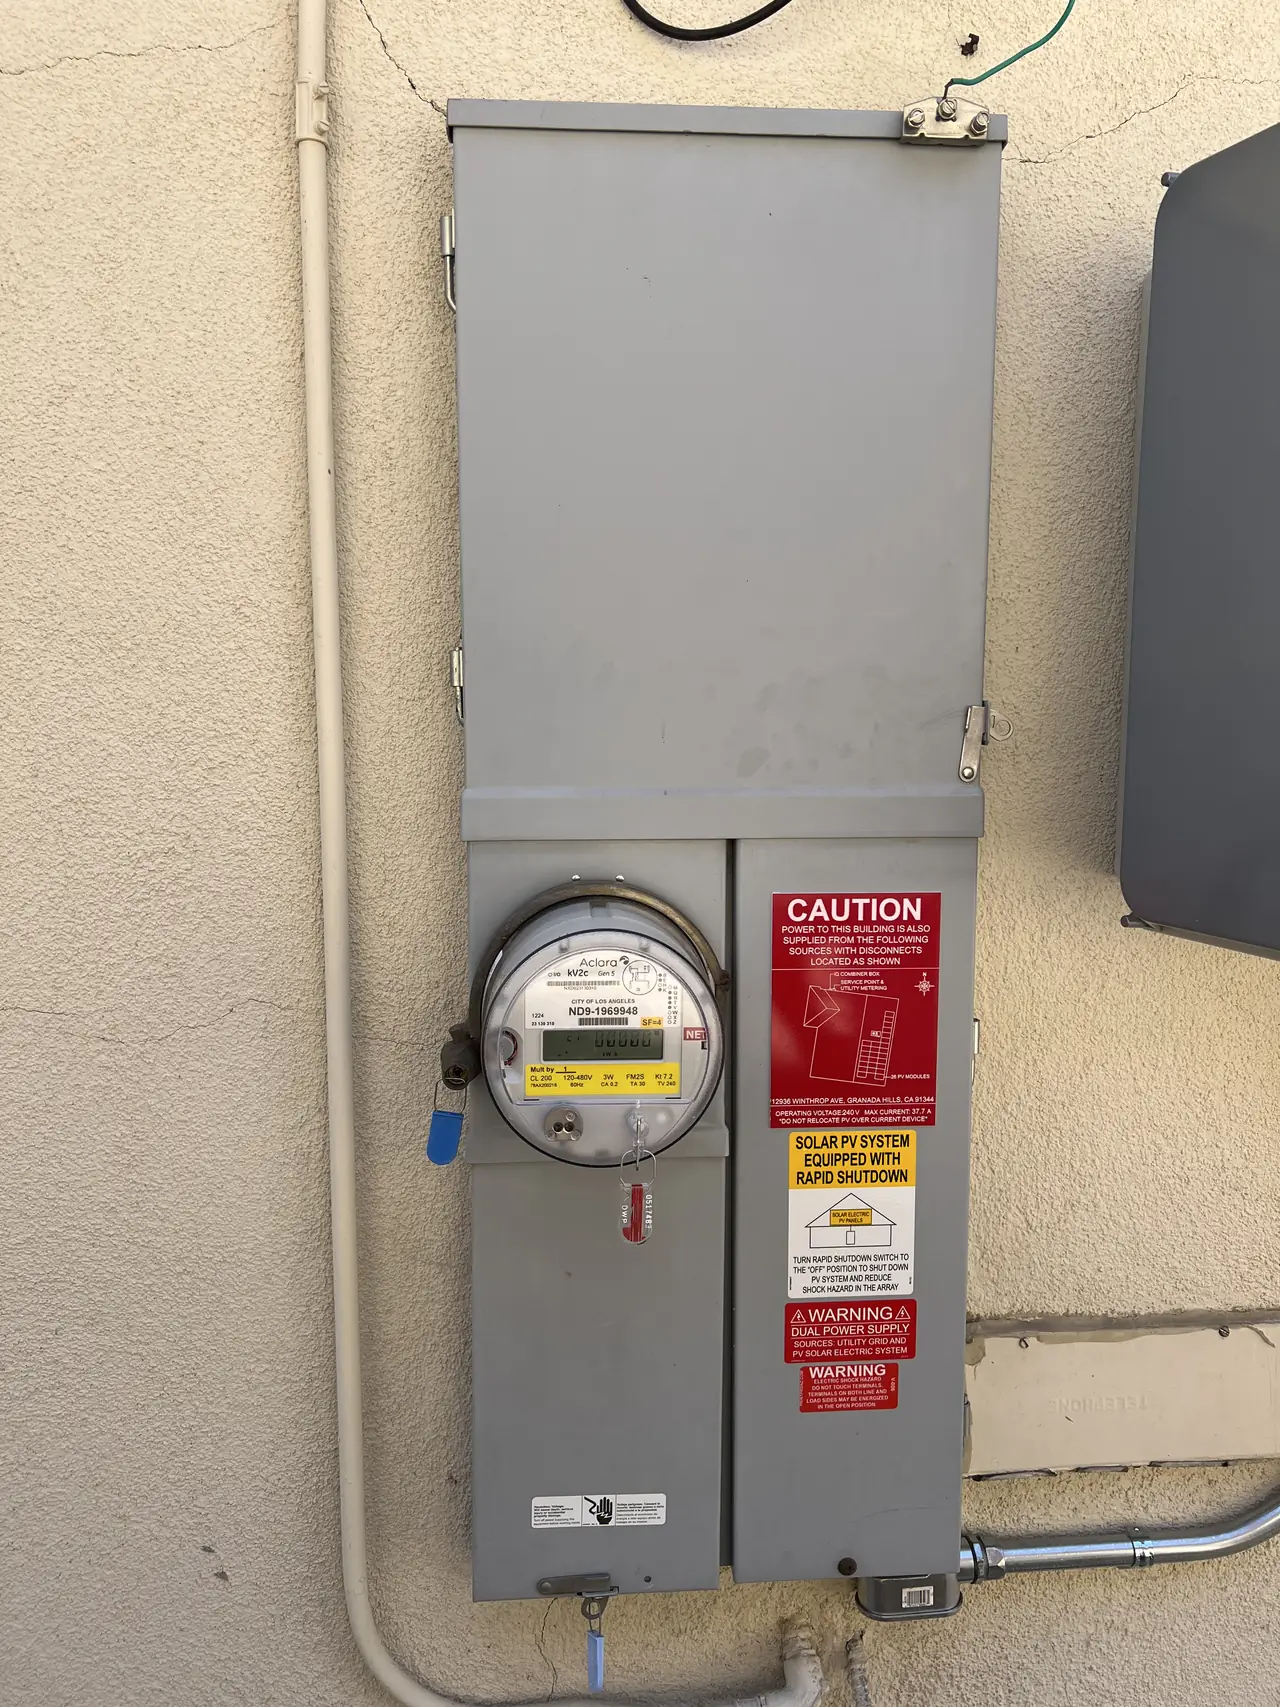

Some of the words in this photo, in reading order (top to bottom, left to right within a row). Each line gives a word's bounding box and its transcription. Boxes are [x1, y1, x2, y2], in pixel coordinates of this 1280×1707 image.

[788, 898, 922, 921] CAUTION
[580, 958, 618, 967] Aclara
[569, 1007, 638, 1015] ND9-1969948
[796, 1136, 838, 1149] SOLAR
[841, 1135, 857, 1148] PV
[860, 1134, 910, 1148] SYSTEM
[804, 1153, 866, 1167] EQUIPPED
[870, 1152, 900, 1166] WITH
[797, 1171, 834, 1185] RAPID
[837, 1169, 908, 1184] SHUTDOWN
[827, 1285, 854, 1293] HAZARD
[808, 1306, 893, 1322] WARNING
[791, 1326, 820, 1337] DUAL
[823, 1325, 864, 1336] POWER
[867, 1324, 910, 1334] SUPPLY
[834, 1348, 873, 1356] ELECTRIC
[809, 1364, 886, 1378] WARNING
